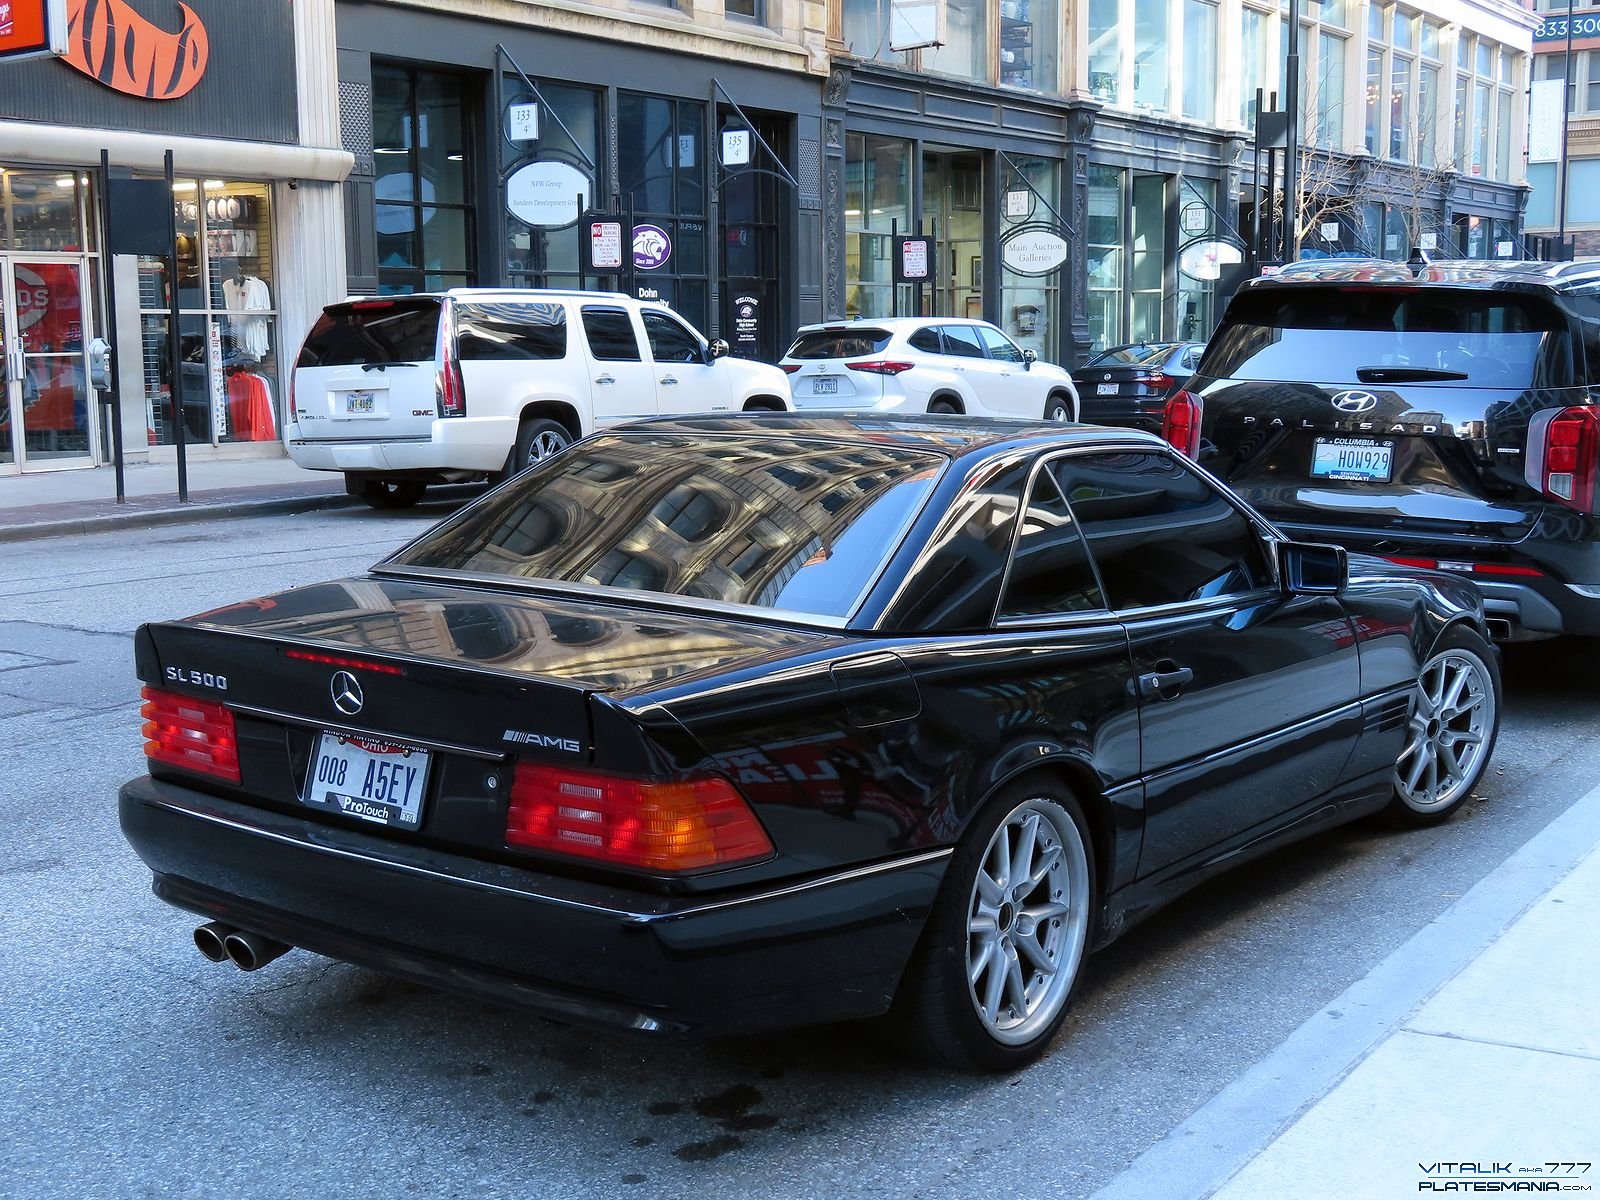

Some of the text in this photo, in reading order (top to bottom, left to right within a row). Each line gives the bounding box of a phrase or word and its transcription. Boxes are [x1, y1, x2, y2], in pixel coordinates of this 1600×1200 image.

[1535, 19, 1600, 37] 833 30
[516, 110, 531, 121] 133
[729, 135, 742, 146] 135
[546, 180, 562, 188] Group
[1008, 243, 1062, 252] Main Auction
[1018, 253, 1052, 262] Galleries
[17, 289, 49, 306] DS
[638, 287, 658, 298] Dohn
[735, 296, 759, 306] WELCOME
[1244, 416, 1470, 435] PALISADE
[1333, 437, 1375, 446] COLUMBIA
[1338, 450, 1389, 470] HOW929
[1328, 474, 1370, 482] CINCINNATI
[166, 666, 228, 690] SL 500
[525, 733, 580, 752] AMG
[318, 755, 418, 806] 008 A5EY
[343, 796, 389, 818] ProTouch
